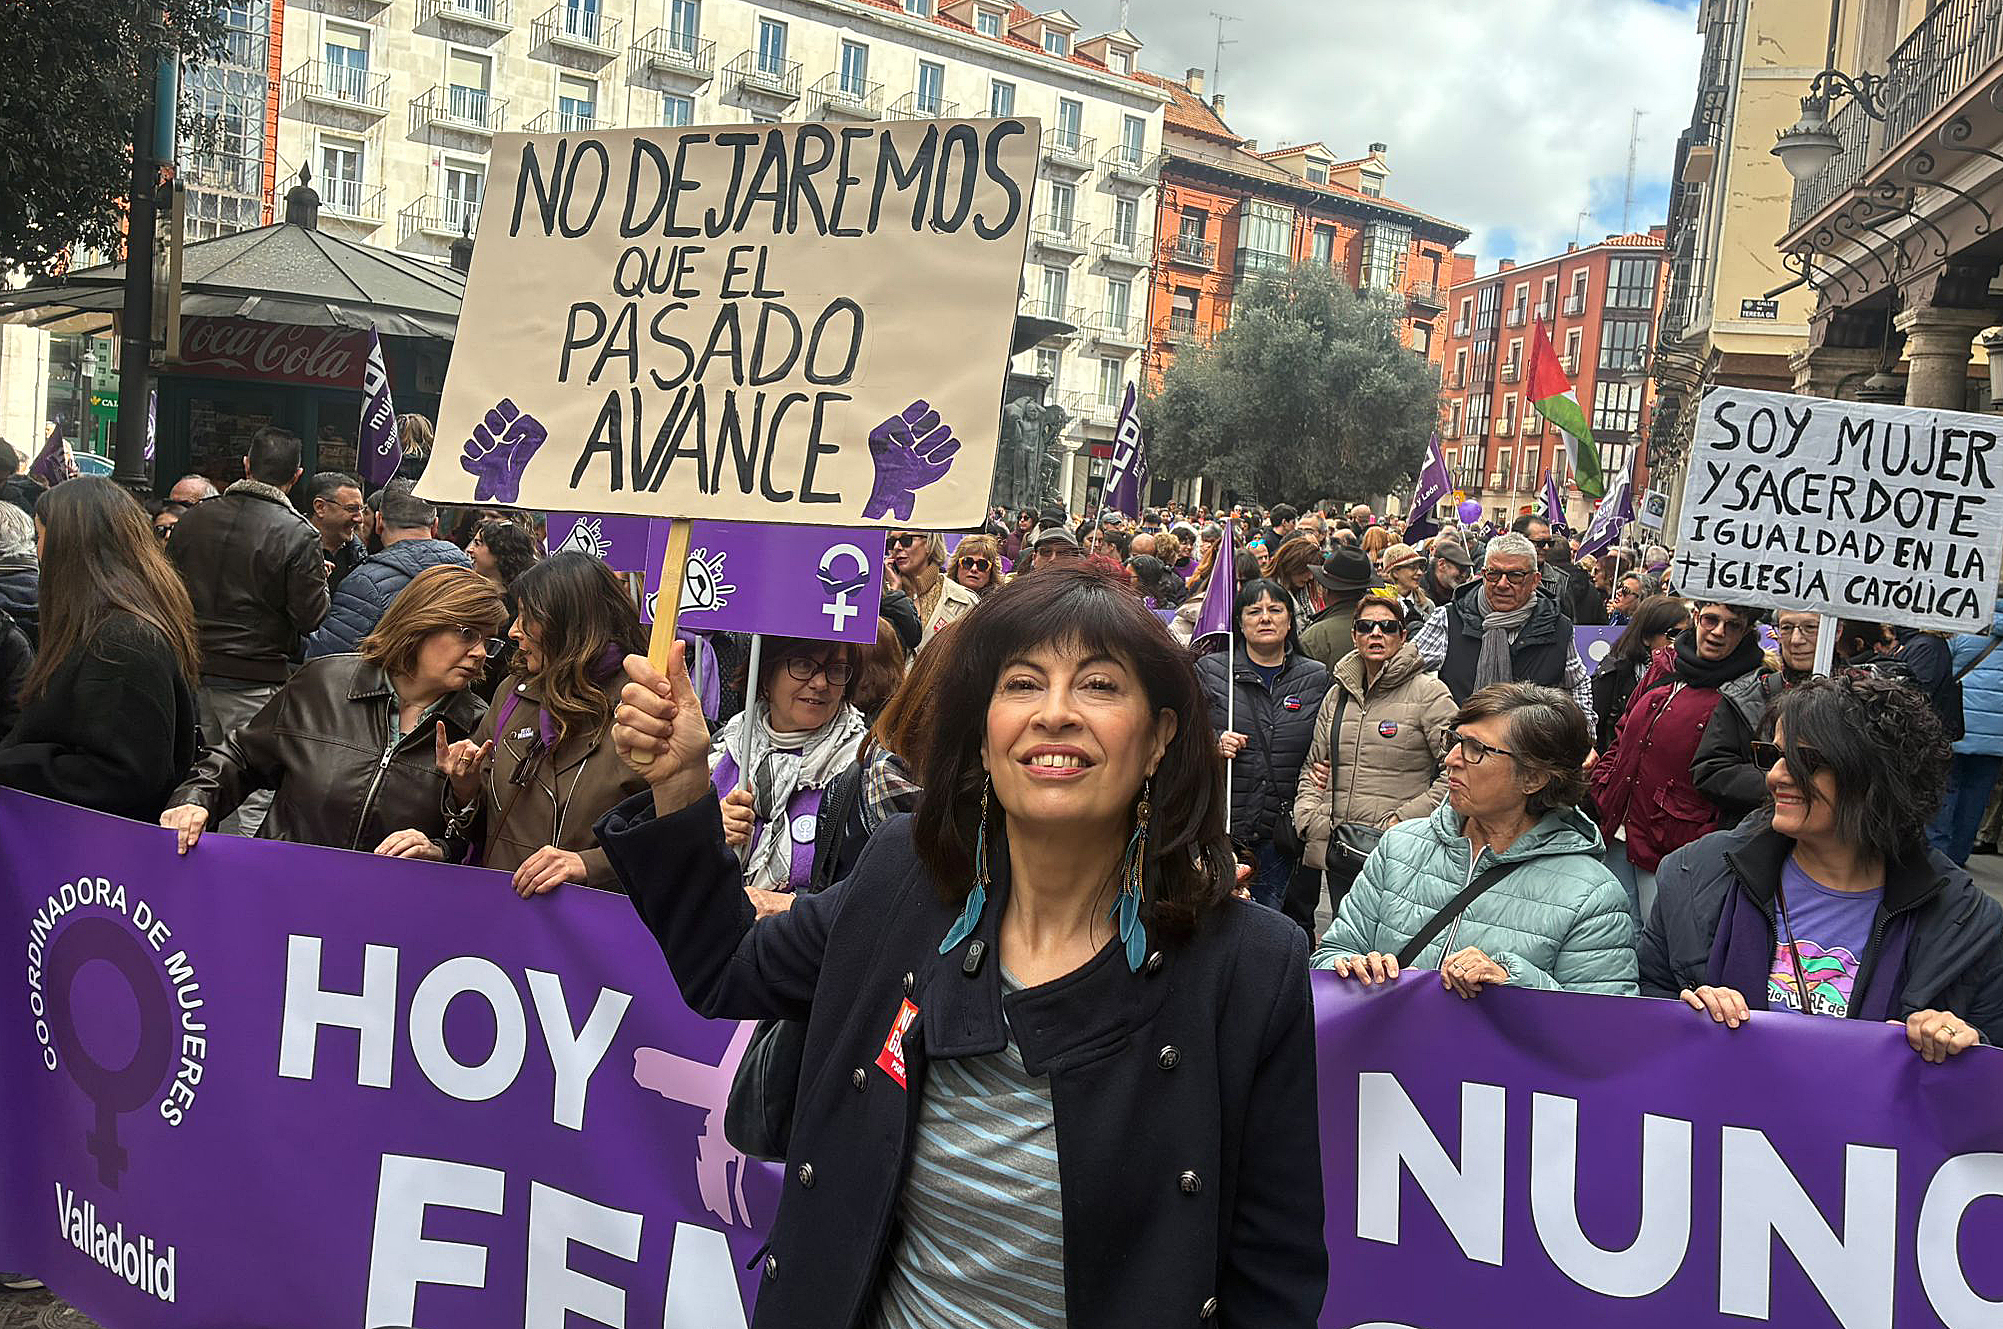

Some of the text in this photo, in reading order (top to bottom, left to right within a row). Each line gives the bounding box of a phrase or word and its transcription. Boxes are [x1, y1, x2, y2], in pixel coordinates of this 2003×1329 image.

[510, 120, 1025, 241] NO DEJAREMOS
[613, 245, 785, 300] QUE EL
[558, 297, 865, 390] PASADO
[570, 384, 853, 504] AVANCE
[1709, 401, 1997, 489] SOY MUJER
[1690, 515, 1985, 582] IGUALDAD EN LA
[1706, 551, 1981, 619] IGLESIA CATÓLICA
[29, 876, 207, 1127] COORDINADORA DE MUJERES
[277, 932, 634, 1132] HOY
[1827, 1003, 1846, 1017] de
[55, 1180, 177, 1303] Valladolid
